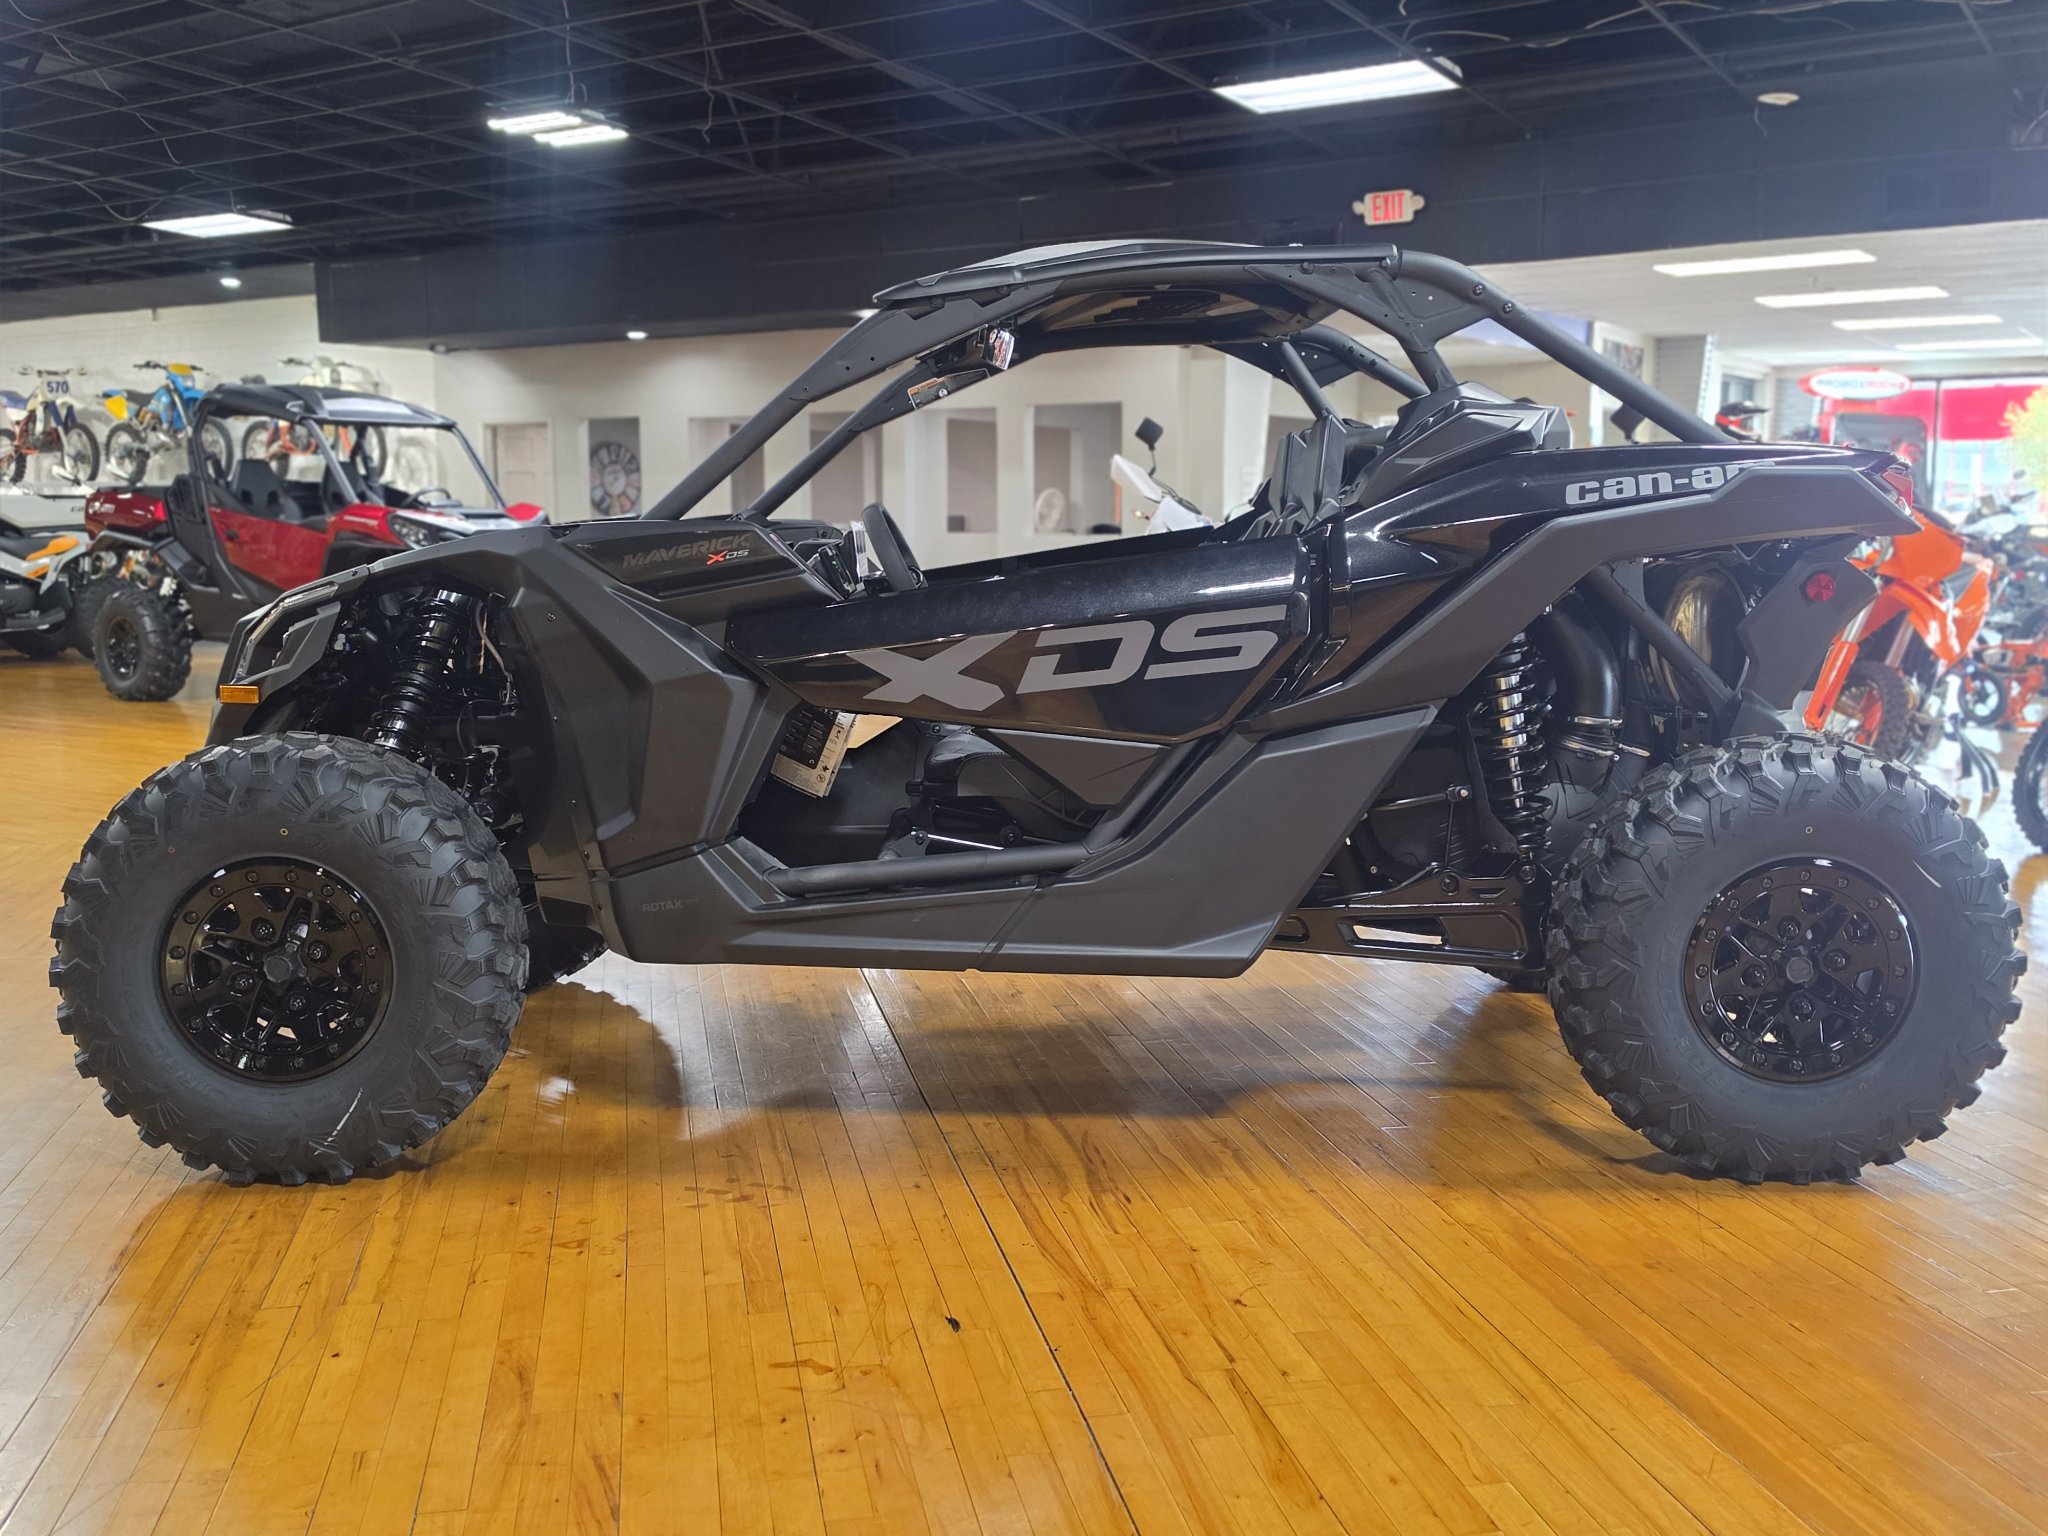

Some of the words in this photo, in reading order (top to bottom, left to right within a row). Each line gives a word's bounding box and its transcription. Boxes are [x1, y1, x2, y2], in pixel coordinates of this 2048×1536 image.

[1372, 192, 1405, 222] EXIT
[47, 381, 69, 394] 570
[623, 533, 751, 569] MAVERICK
[706, 549, 750, 565] XDS
[846, 604, 1287, 711] XDS
[642, 900, 683, 912] ROTAX
